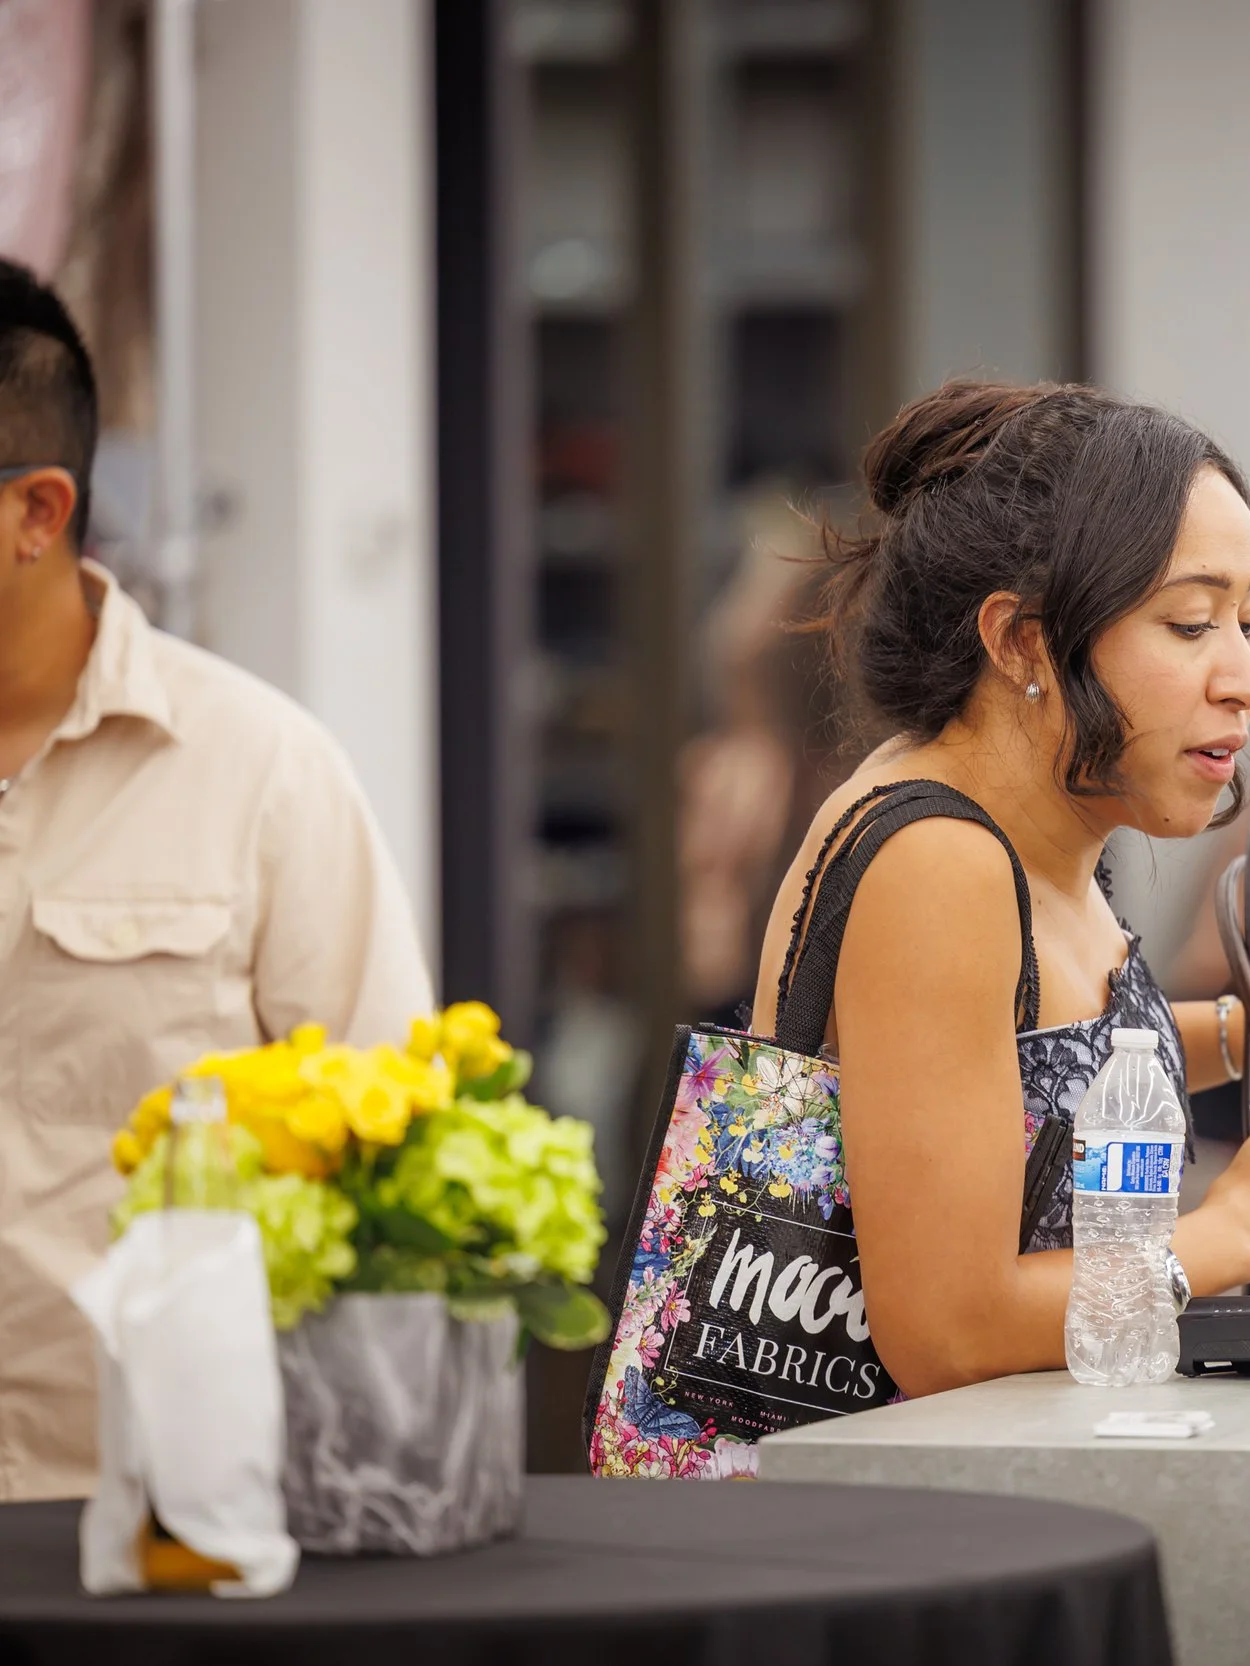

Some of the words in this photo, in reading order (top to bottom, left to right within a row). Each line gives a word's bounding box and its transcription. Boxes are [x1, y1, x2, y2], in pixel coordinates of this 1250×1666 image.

[693, 1322, 880, 1399] FABRICS
[684, 1391, 705, 1401] NEW
[709, 1397, 734, 1408] YORK
[760, 1411, 787, 1422] MIAMI
